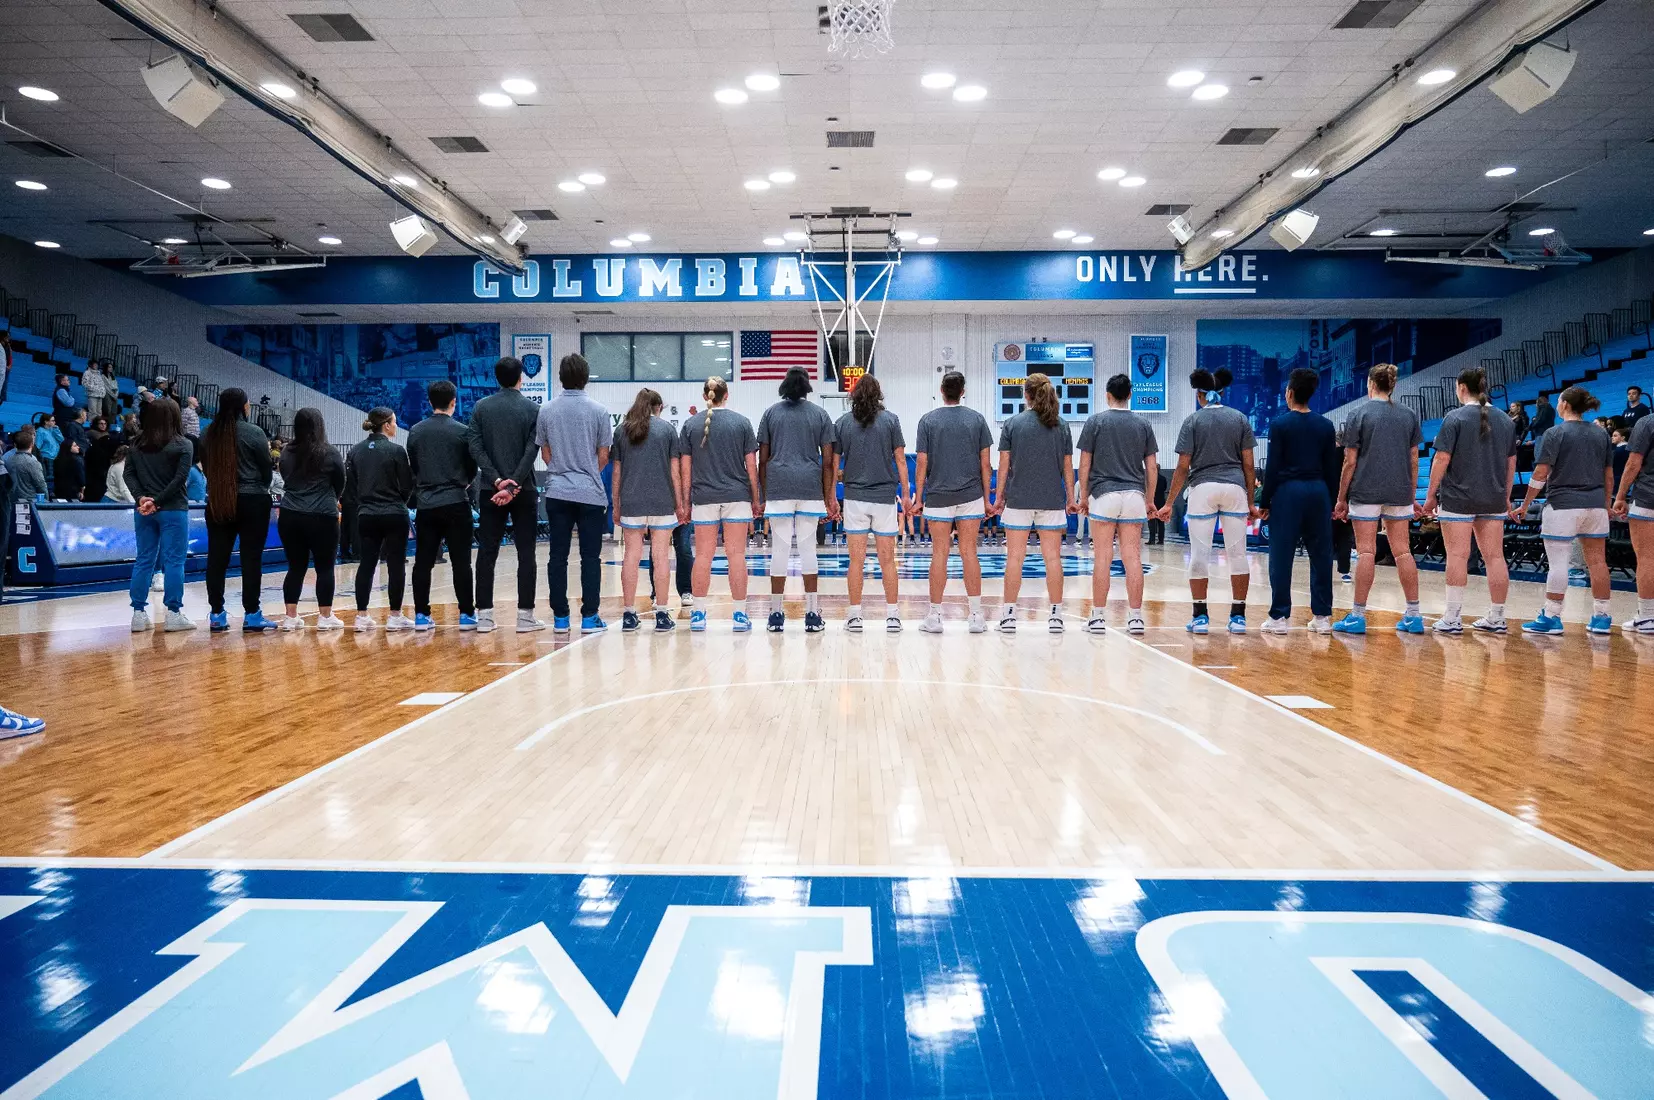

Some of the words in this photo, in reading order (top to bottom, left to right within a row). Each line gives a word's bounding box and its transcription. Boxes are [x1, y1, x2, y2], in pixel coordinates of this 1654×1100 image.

[473, 257, 806, 298] COLUMBIA
[1076, 255, 1157, 282] ONLY
[842, 368, 864, 376] 10:00
[1136, 396, 1160, 405] 1968
[17, 546, 37, 573] C
